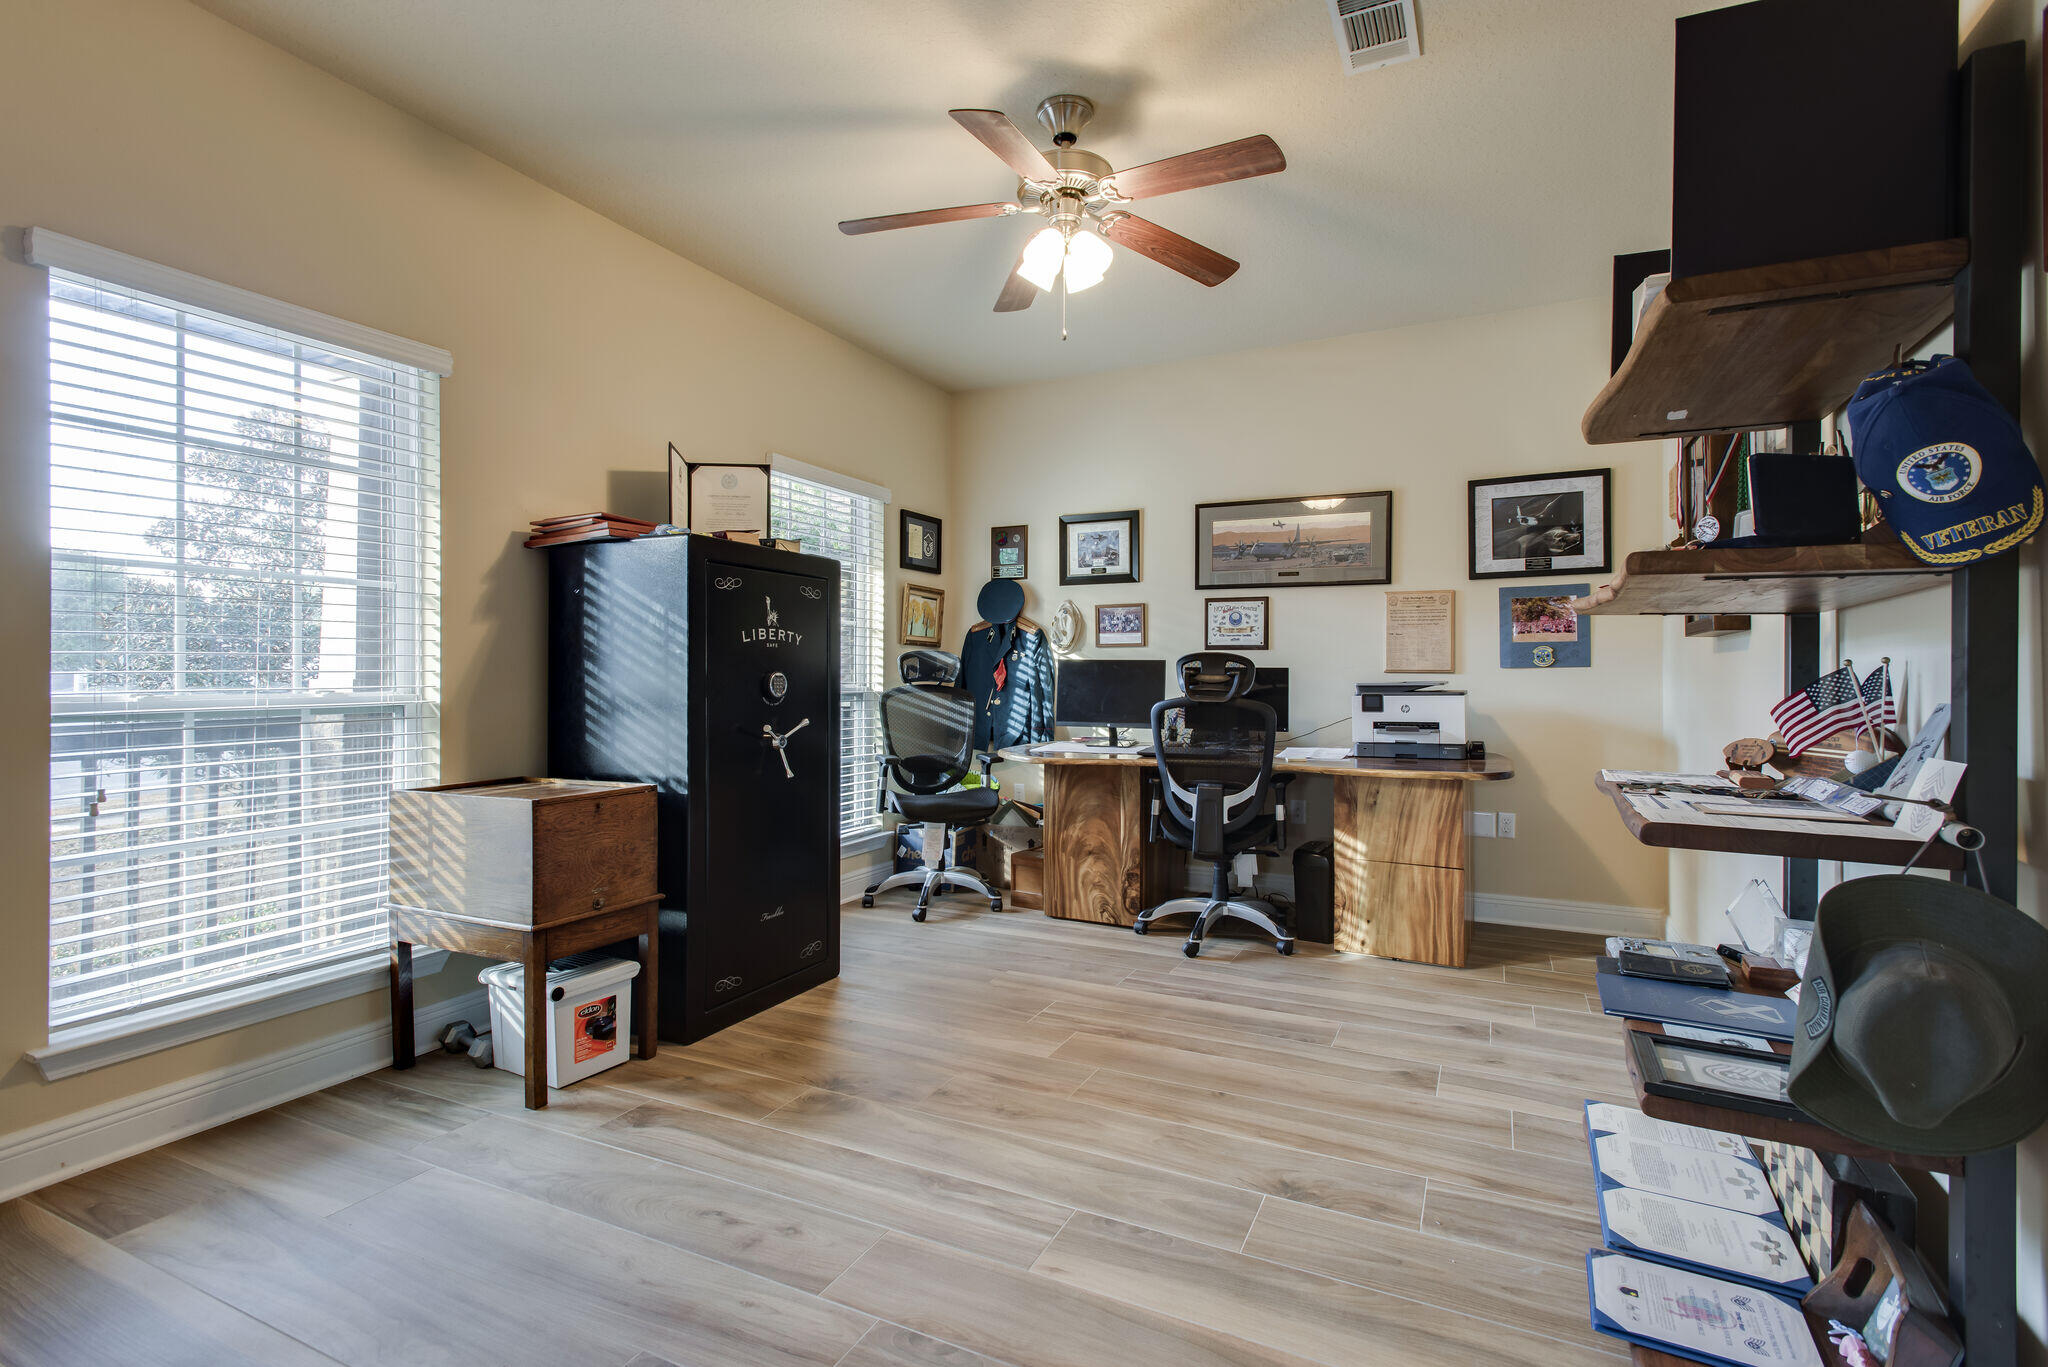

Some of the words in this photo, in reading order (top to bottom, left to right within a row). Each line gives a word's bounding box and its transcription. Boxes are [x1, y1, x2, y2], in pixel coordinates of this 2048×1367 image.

[1899, 451, 1925, 475] UNITED
[1928, 445, 1965, 453] STATES
[1948, 481, 1975, 501] FORCE
[1920, 503, 2029, 550] VETERAN
[742, 628, 802, 646] LIBERTY
[1815, 981, 1827, 995] AIR
